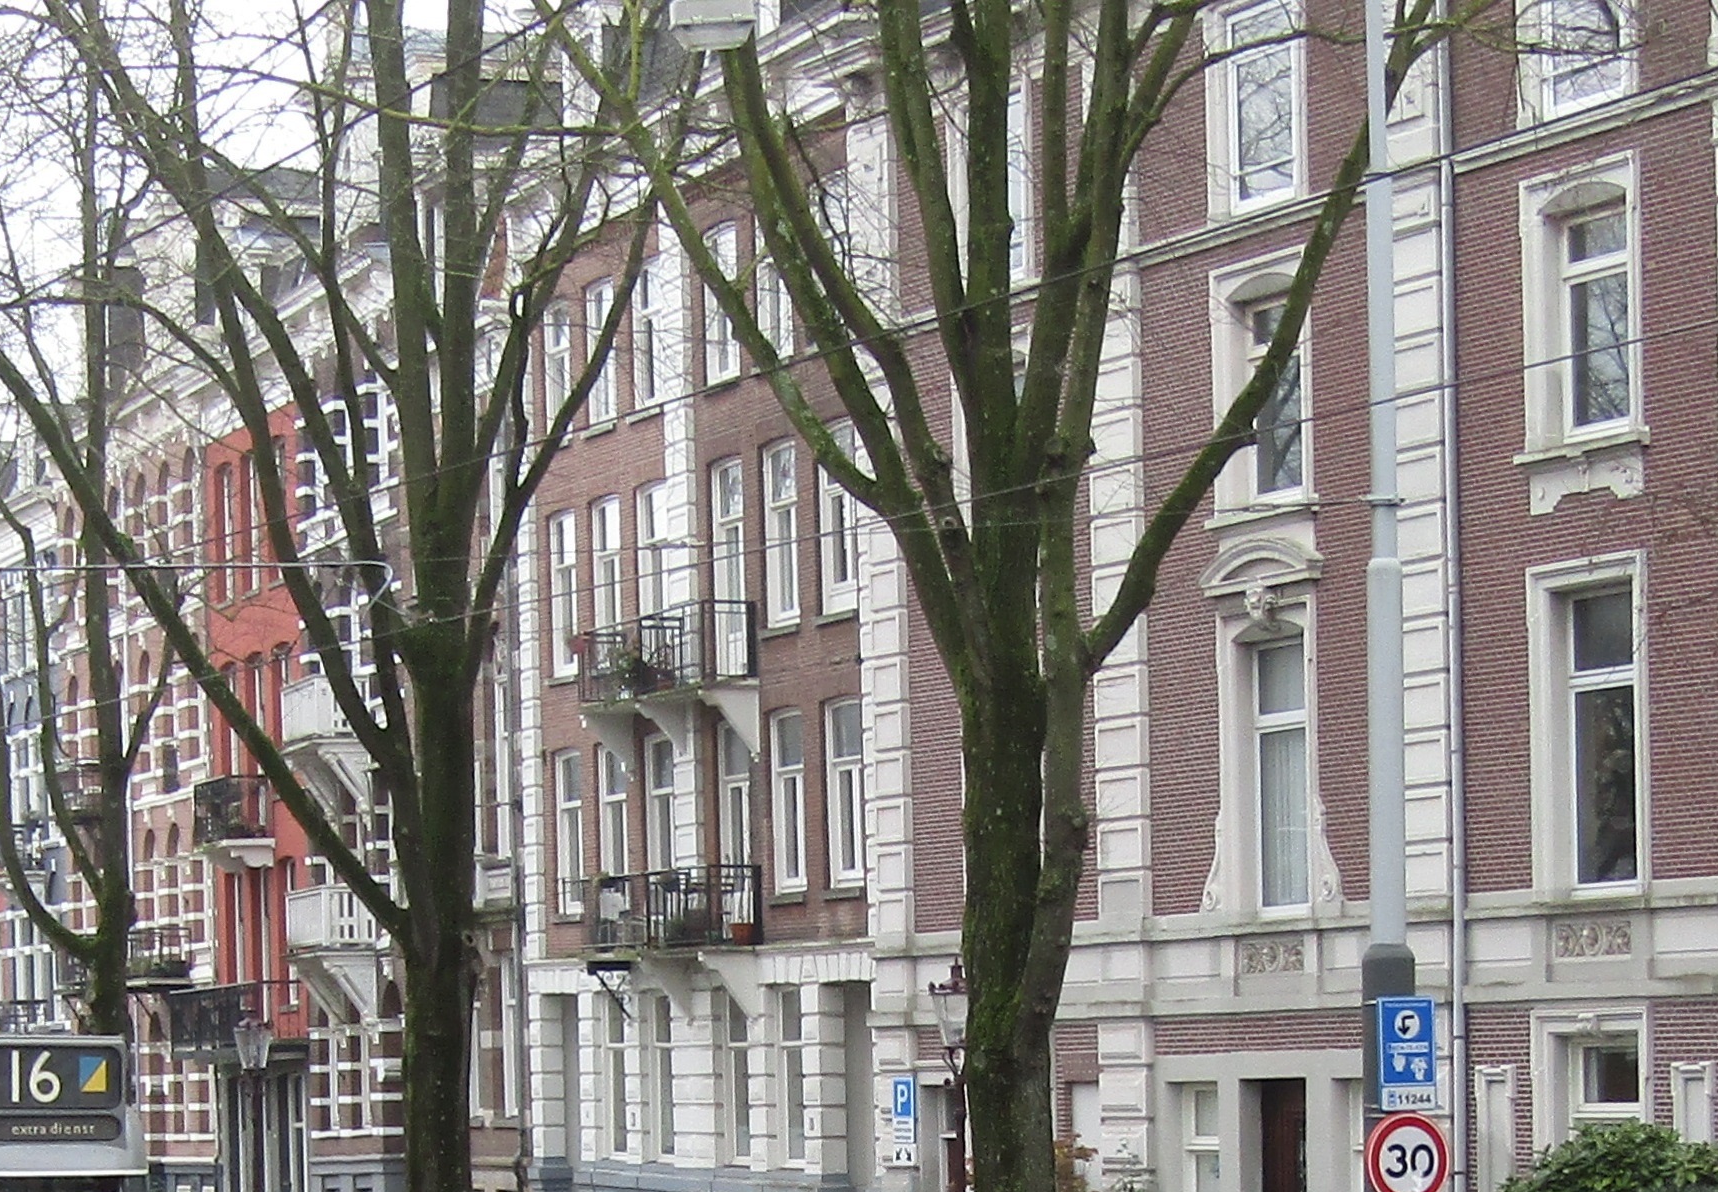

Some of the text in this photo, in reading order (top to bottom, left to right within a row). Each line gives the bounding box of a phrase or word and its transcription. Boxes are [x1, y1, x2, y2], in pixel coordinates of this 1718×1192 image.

[11, 1050, 61, 1103] 16
[896, 1084, 908, 1113] P
[11, 1125, 47, 1136] extra
[1385, 1143, 1434, 1179] 30
